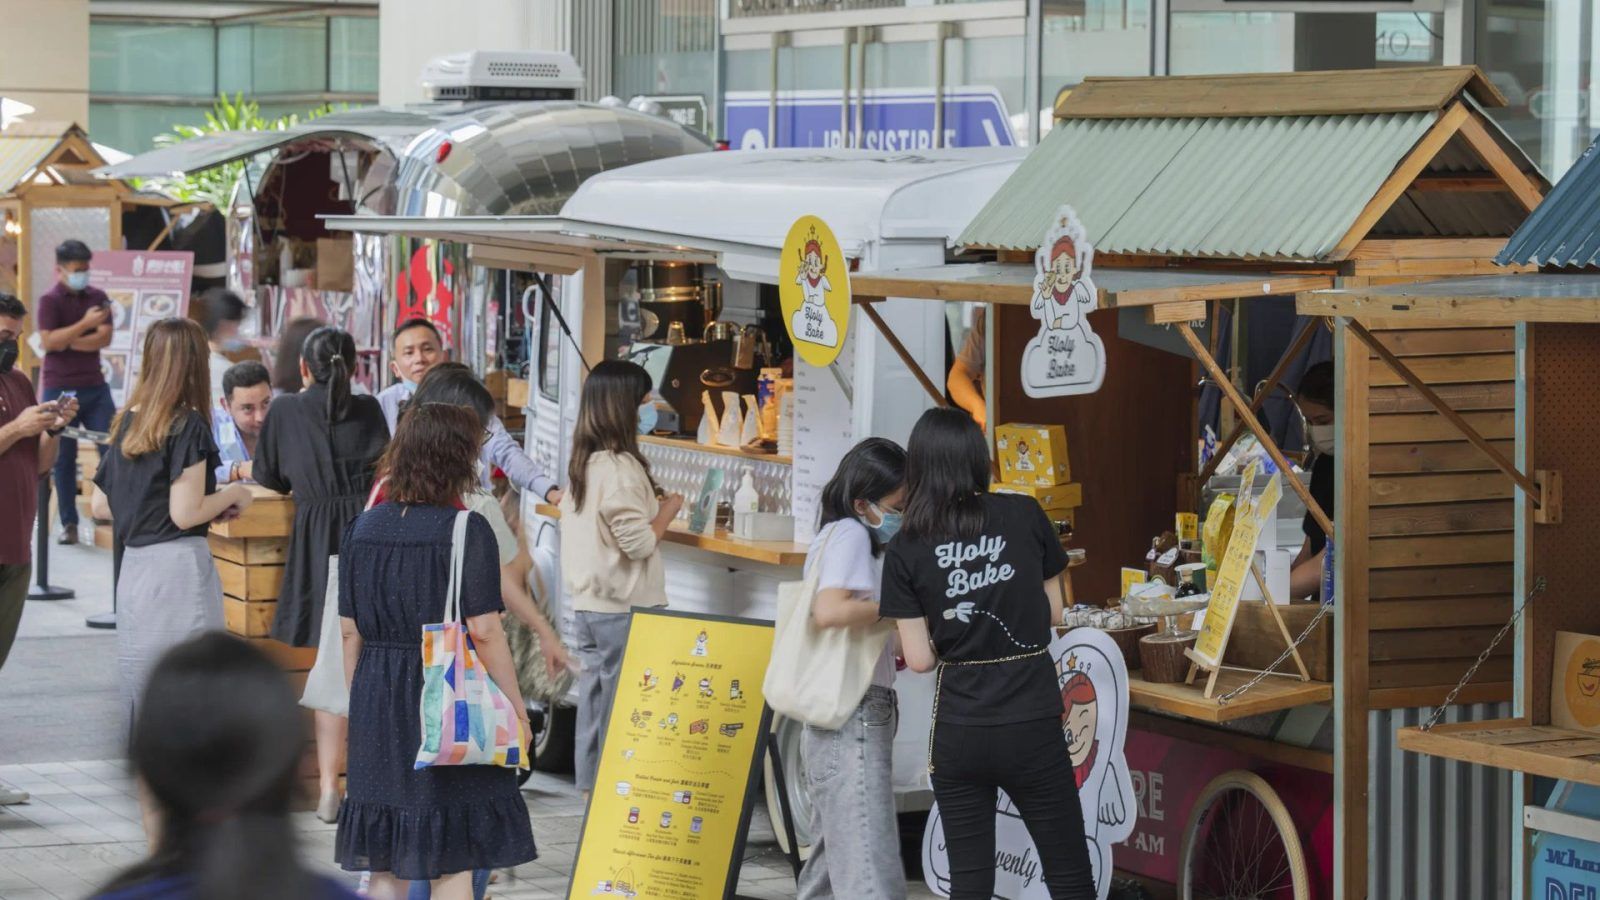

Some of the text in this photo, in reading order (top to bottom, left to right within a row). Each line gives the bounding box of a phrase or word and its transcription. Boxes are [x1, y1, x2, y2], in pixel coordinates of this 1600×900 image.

[805, 306, 823, 327] Holy
[805, 322, 824, 340] Bake
[1048, 335, 1075, 359] Holy
[1046, 358, 1076, 379] Bake
[935, 535, 1006, 568] Holy
[945, 563, 1015, 598] Bake
